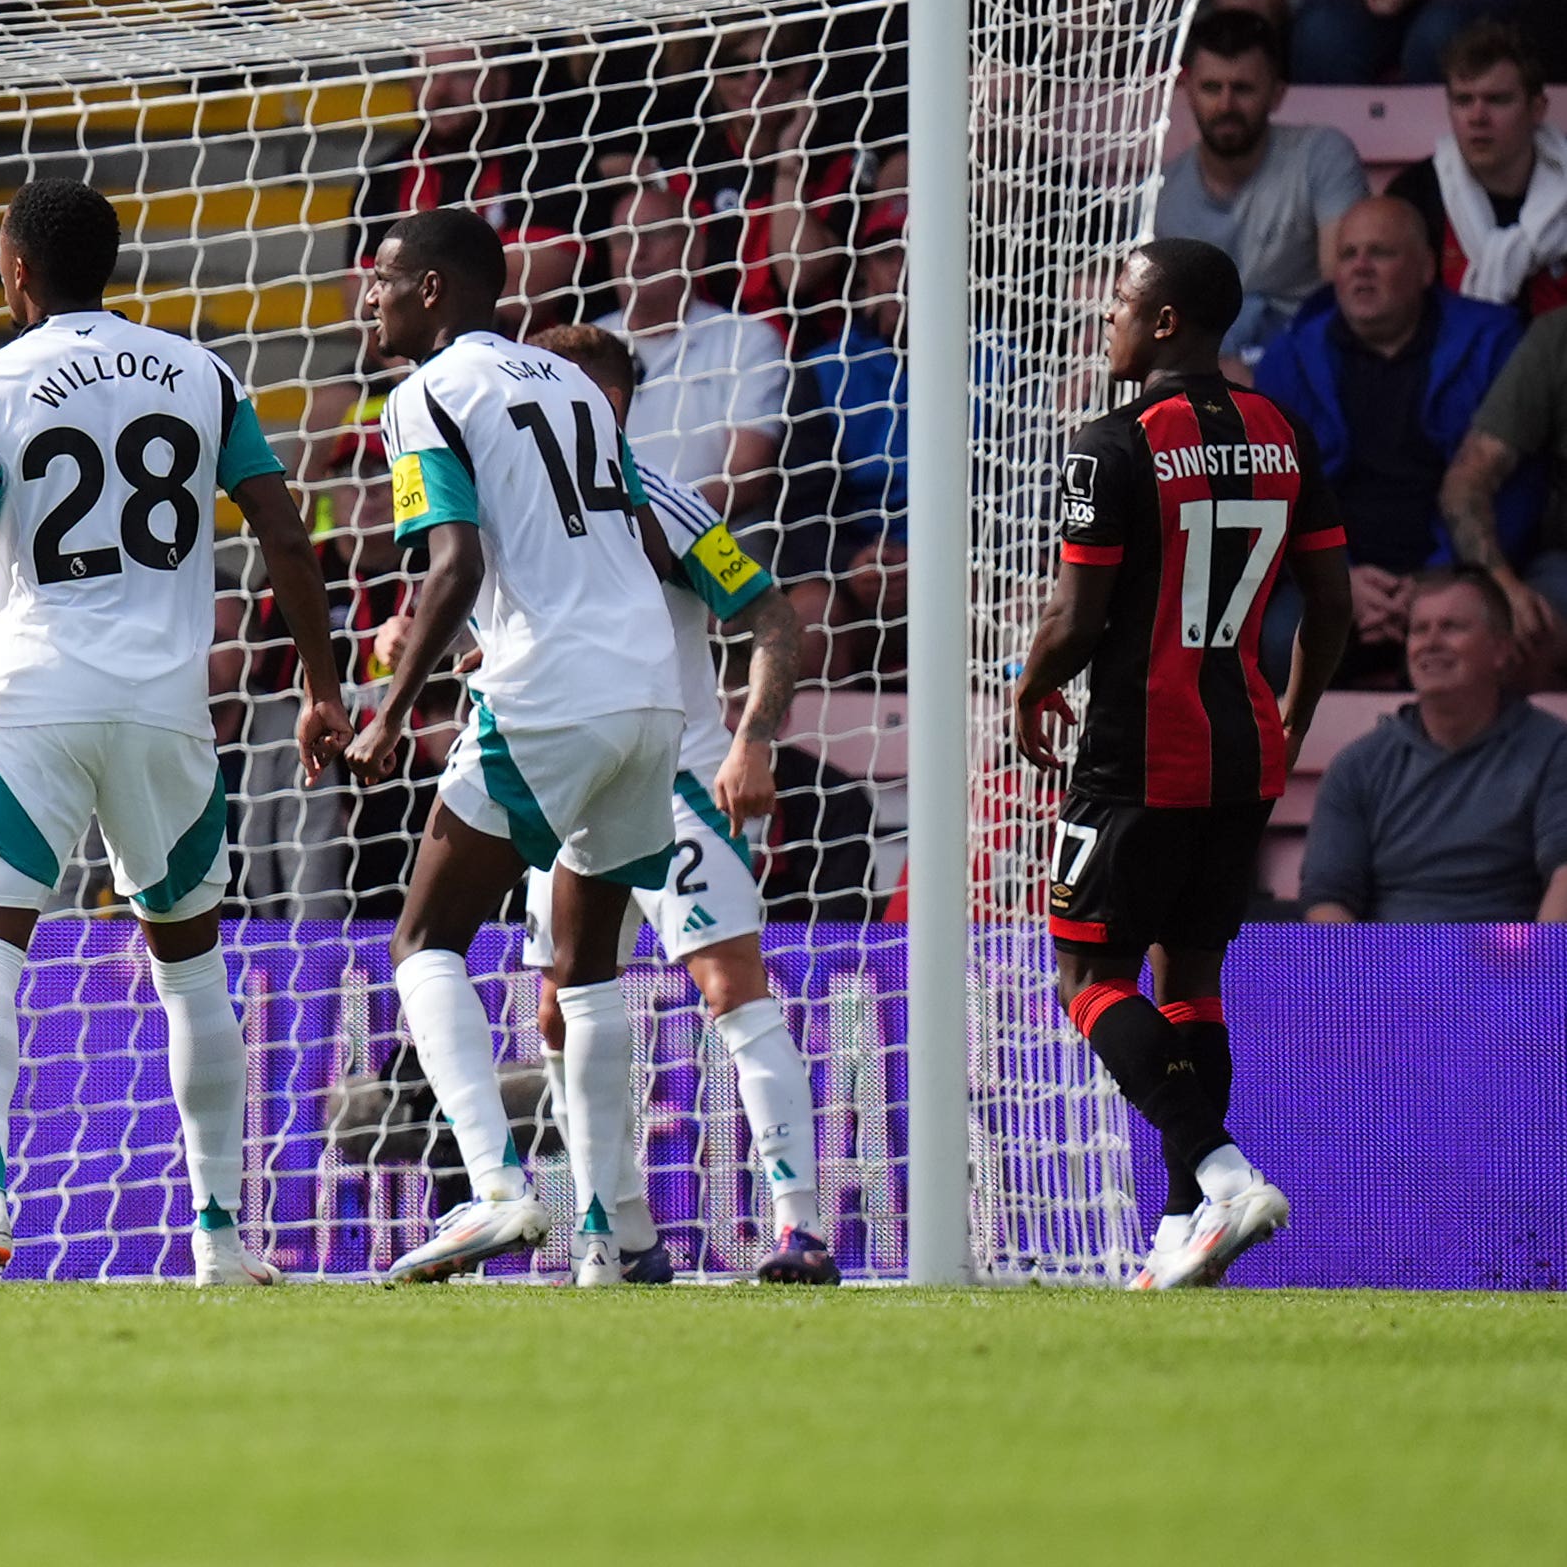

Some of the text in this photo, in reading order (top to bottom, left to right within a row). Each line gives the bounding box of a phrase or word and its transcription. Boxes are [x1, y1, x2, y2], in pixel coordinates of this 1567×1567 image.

[32, 351, 184, 408] WILLOCK
[496, 360, 563, 382] ISAK
[507, 400, 636, 539] 14
[1154, 442, 1300, 482] SINISTERRA
[22, 413, 200, 585] 28
[1179, 499, 1288, 649] 17
[673, 839, 708, 898] 2
[1049, 818, 1099, 887] 17
